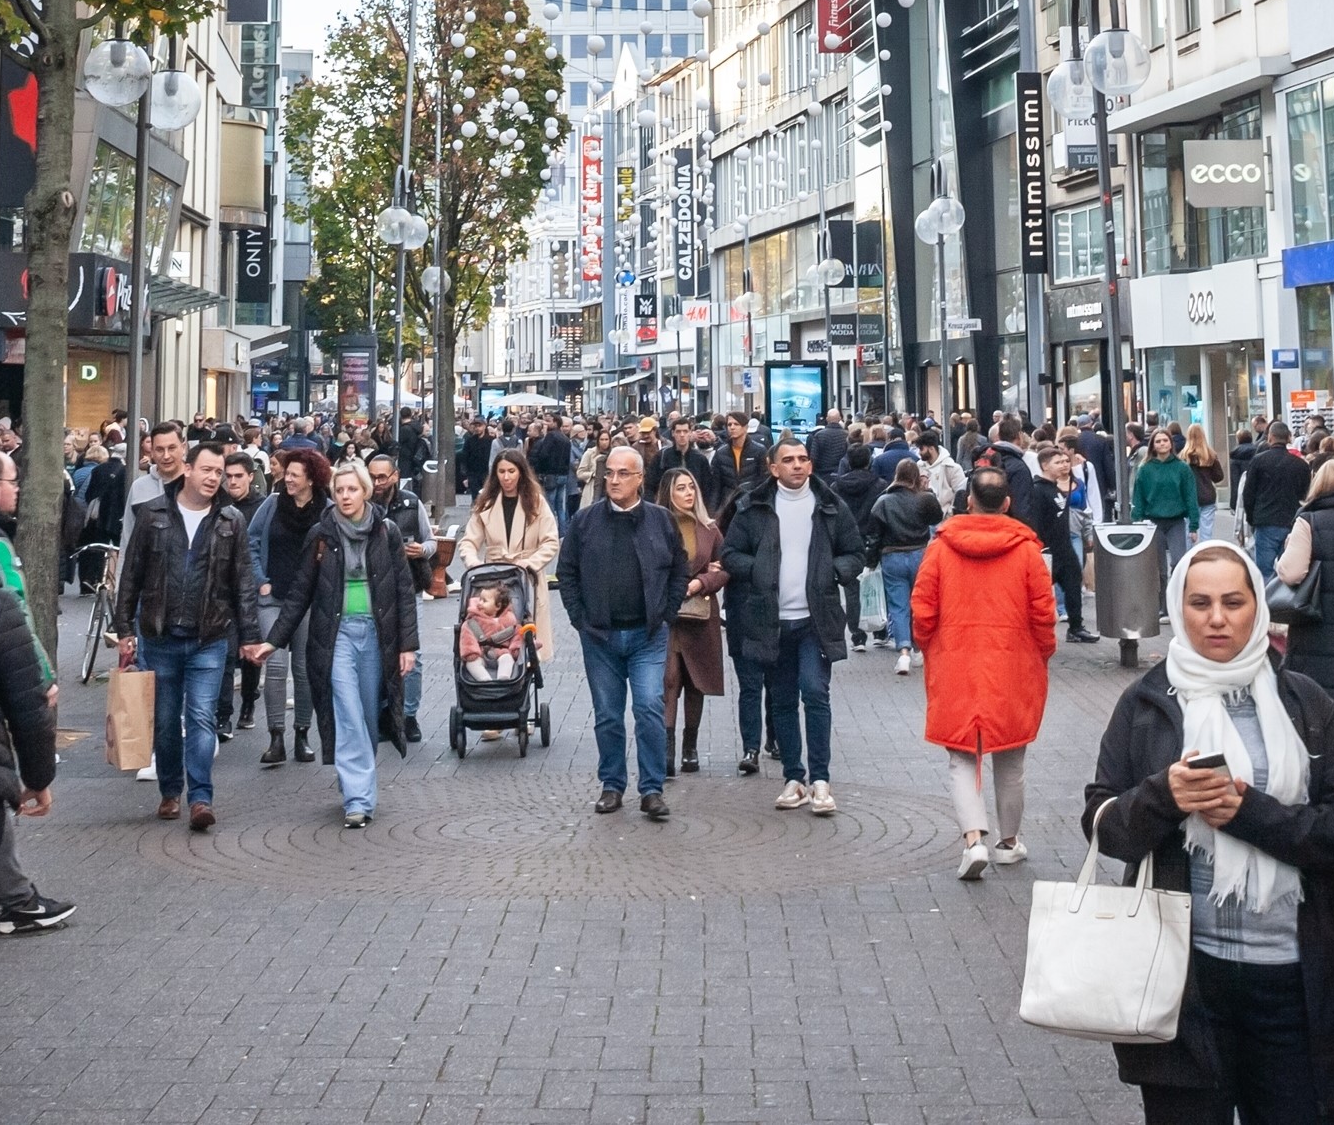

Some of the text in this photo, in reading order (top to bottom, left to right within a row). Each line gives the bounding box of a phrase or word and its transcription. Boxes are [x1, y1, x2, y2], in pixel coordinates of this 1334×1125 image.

[678, 163, 692, 281] CALZEDONIA
[1024, 88, 1044, 257] intimissimi
[1190, 163, 1262, 184] ecco
